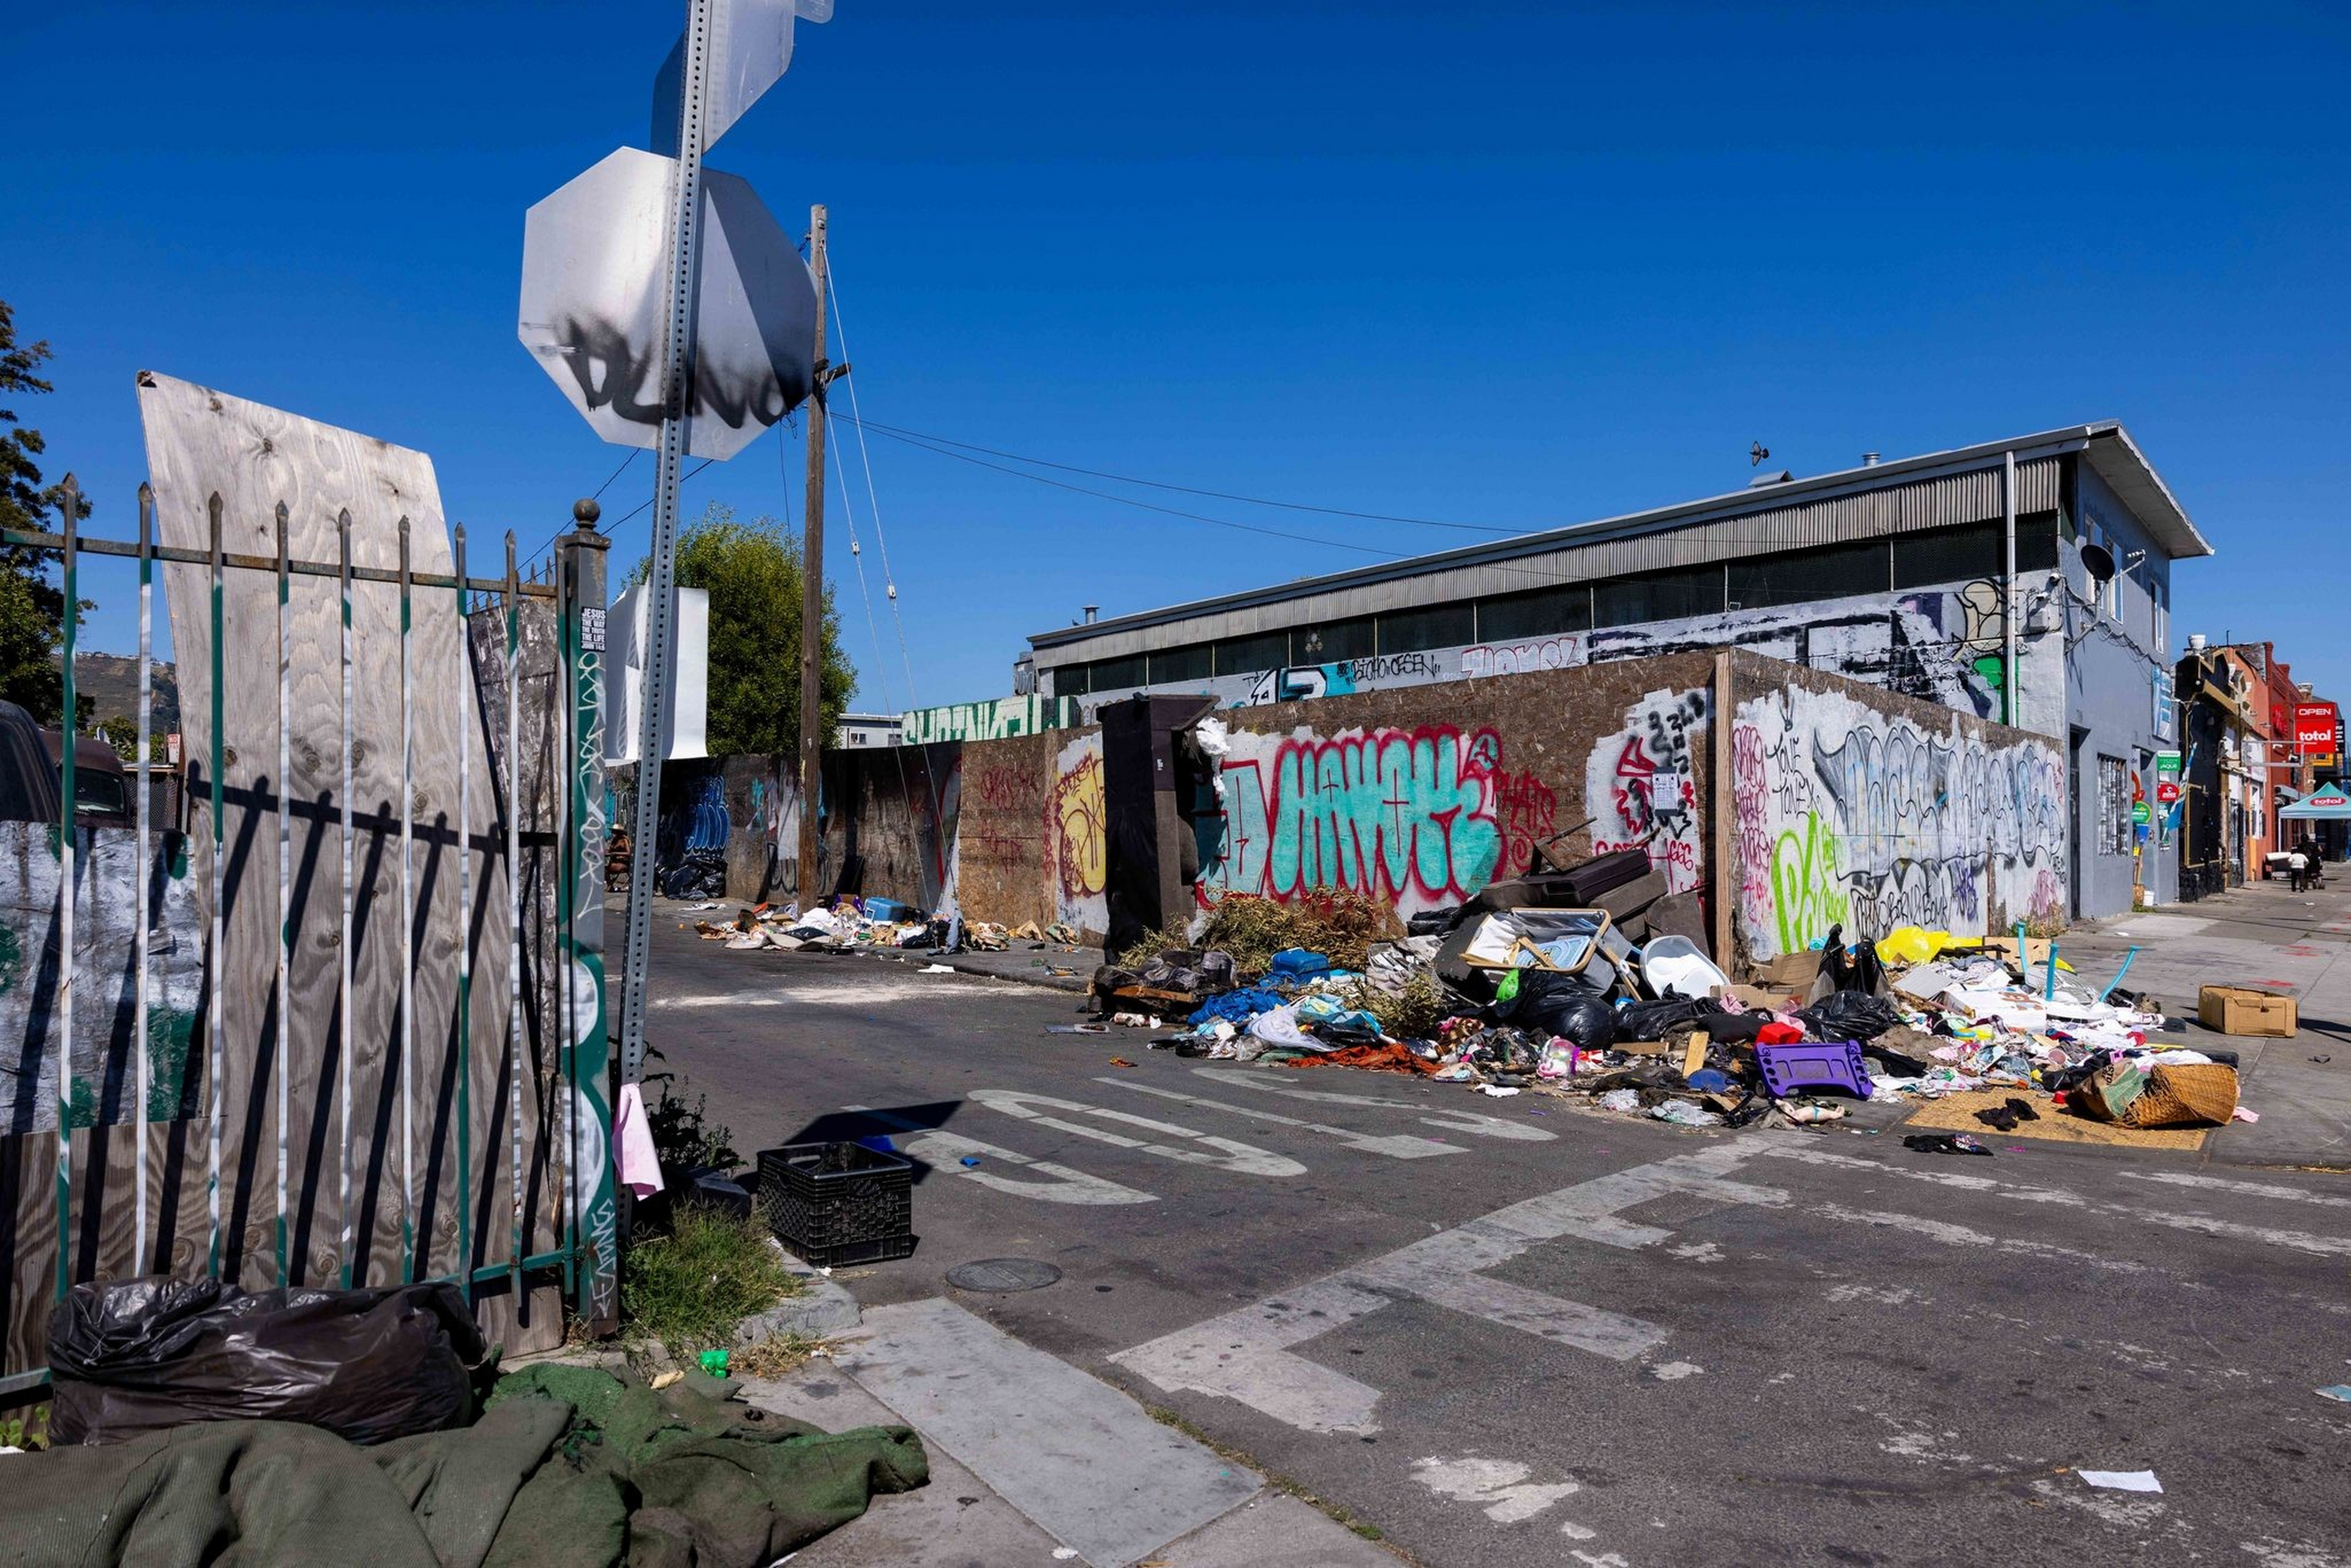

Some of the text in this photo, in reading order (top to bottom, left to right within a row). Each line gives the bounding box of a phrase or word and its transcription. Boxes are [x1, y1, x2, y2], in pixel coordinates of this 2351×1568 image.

[582, 608, 606, 619] JESUS
[582, 632, 605, 643] THE LIFE
[2299, 729, 2331, 741] total
